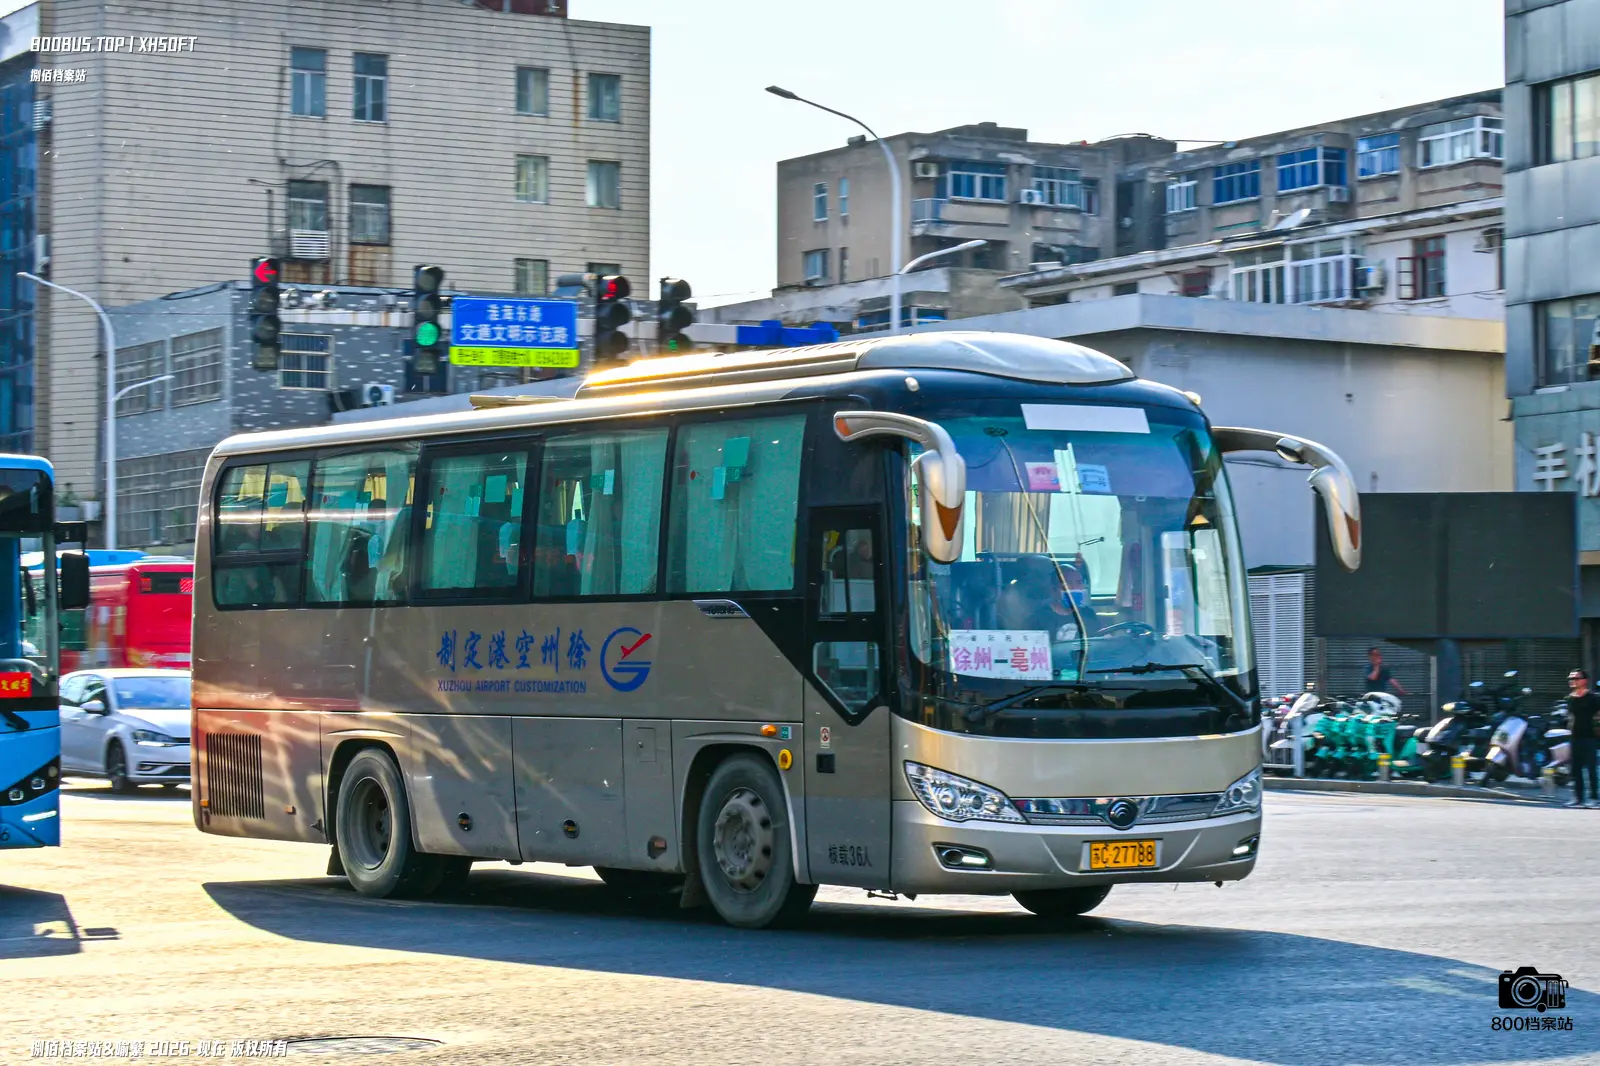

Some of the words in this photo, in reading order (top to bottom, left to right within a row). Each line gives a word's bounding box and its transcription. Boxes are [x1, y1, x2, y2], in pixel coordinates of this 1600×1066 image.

[460, 324, 569, 343] 交通文明示范路
[437, 680, 472, 692] XUZHOU
[475, 680, 511, 693] AIRPORT
[514, 681, 587, 693] CUSTOMIZATION
